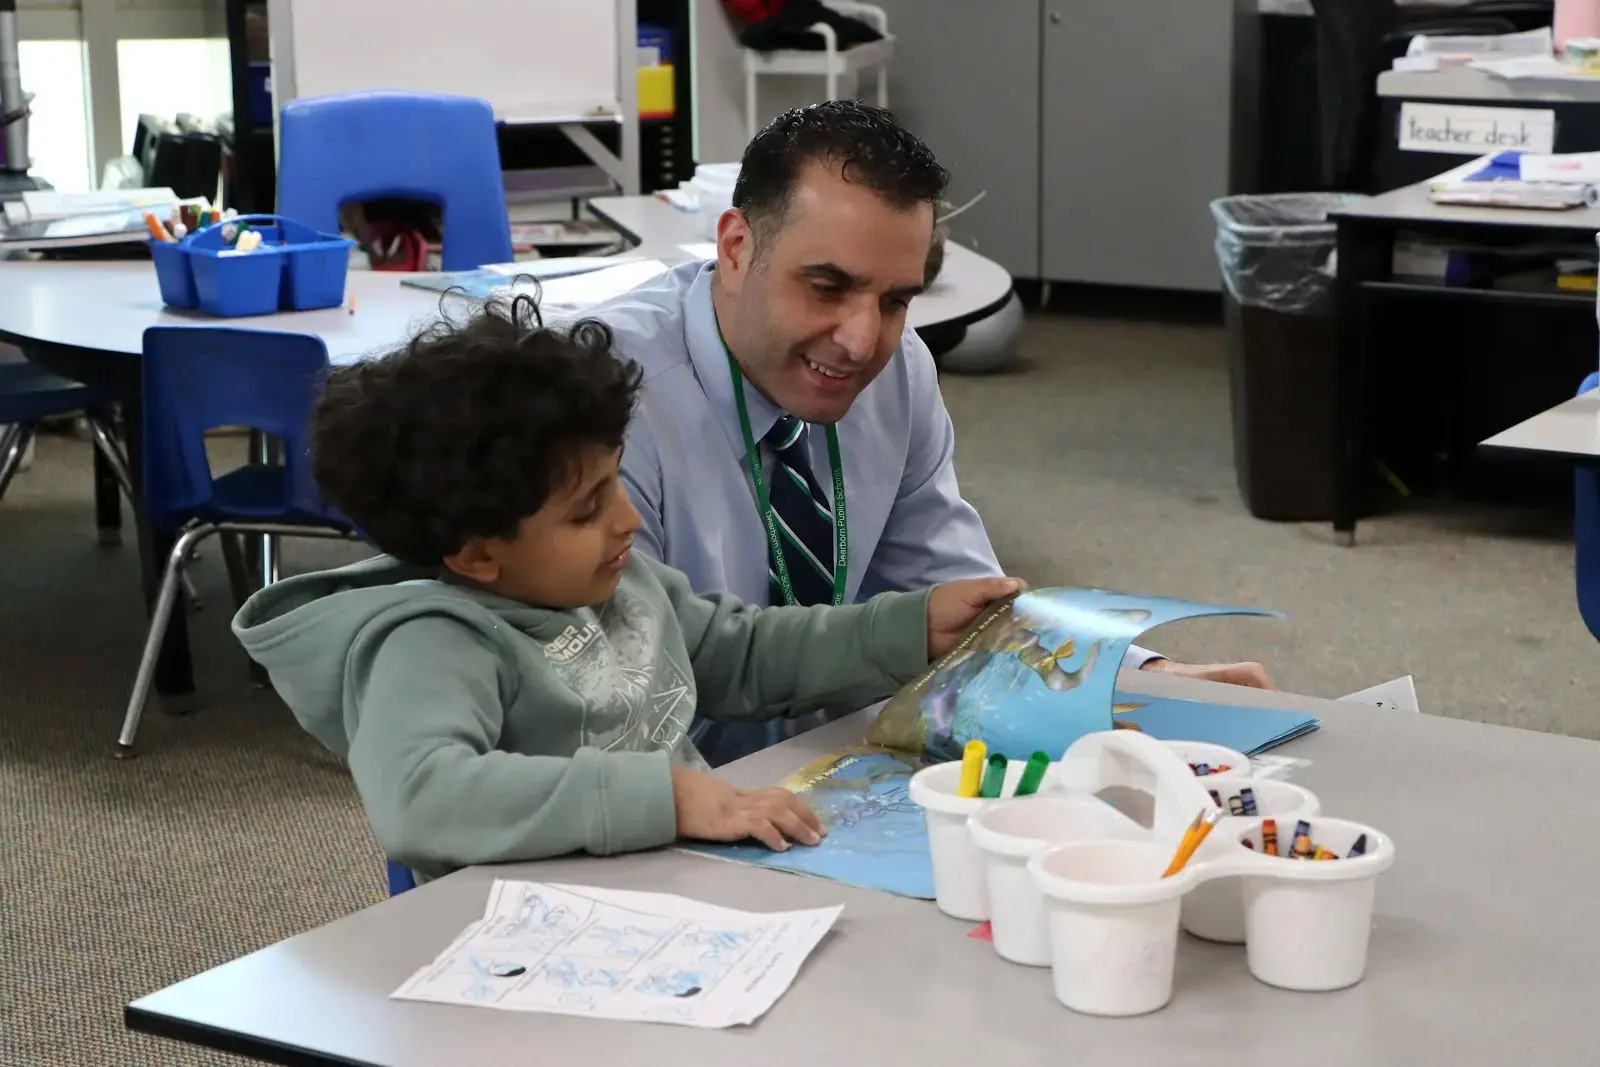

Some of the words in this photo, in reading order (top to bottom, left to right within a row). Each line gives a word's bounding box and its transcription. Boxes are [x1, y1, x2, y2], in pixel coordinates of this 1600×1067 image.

[1408, 115, 1473, 143] teacher
[1484, 120, 1532, 146] desk
[834, 467, 844, 500] Schools
[837, 502, 845, 527] Public
[764, 510, 779, 549] Dearborn
[776, 549, 786, 573] Public
[838, 528, 847, 567] Dearborn
[544, 625, 579, 654] DER
[958, 631, 978, 649] with
